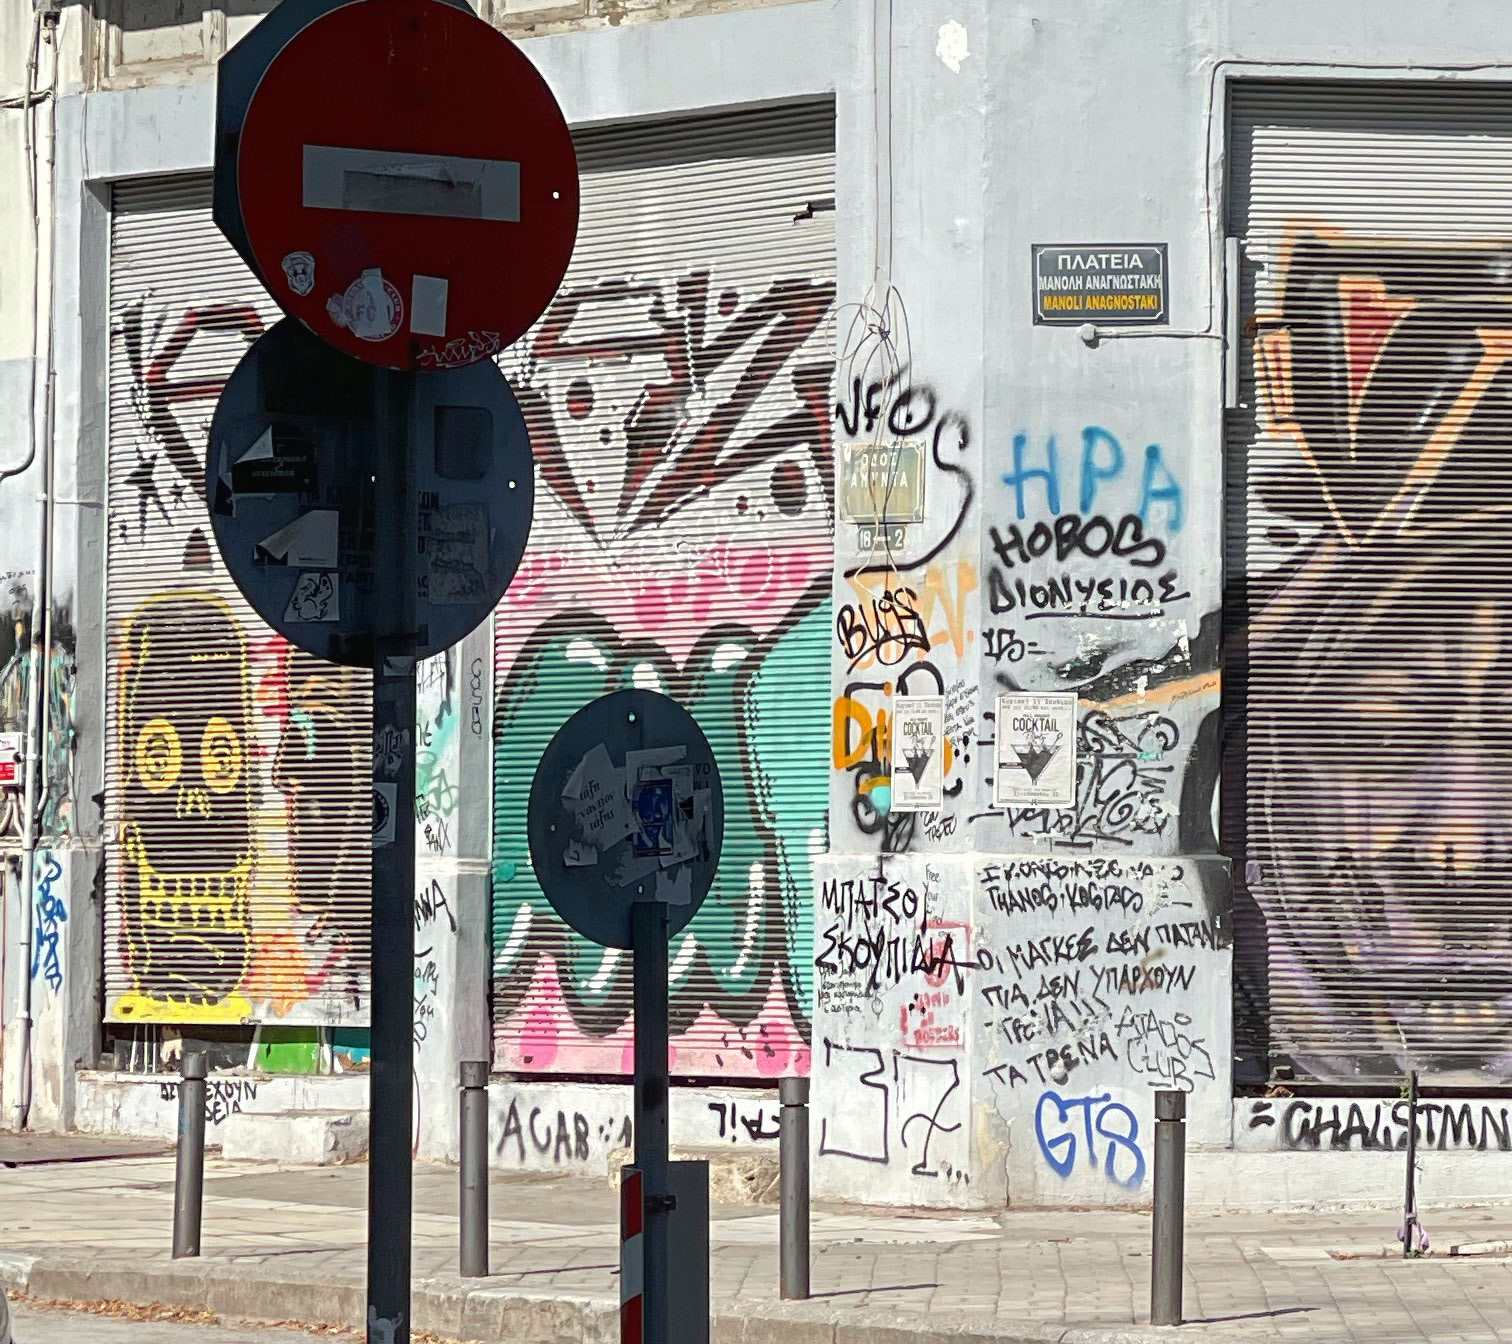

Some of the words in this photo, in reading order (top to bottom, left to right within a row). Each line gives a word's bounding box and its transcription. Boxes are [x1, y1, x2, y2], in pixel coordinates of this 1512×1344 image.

[1058, 253, 1144, 270] ΠΛΑΤΕΙΑ
[1039, 275, 1083, 290] ΜΑΝΟΛΗ
[1085, 274, 1161, 290] ΑΝΑΓΝΩΣΤΑΚΗ
[1044, 295, 1083, 310] MANOLI
[1085, 294, 1158, 310] ANAGNOSTAKI
[903, 722, 933, 736] COCKTAIL
[1012, 717, 1060, 732] COCKTAIL
[1106, 925, 1150, 955] ΔΕΝ
[1037, 970, 1080, 999] ΔΕΝ
